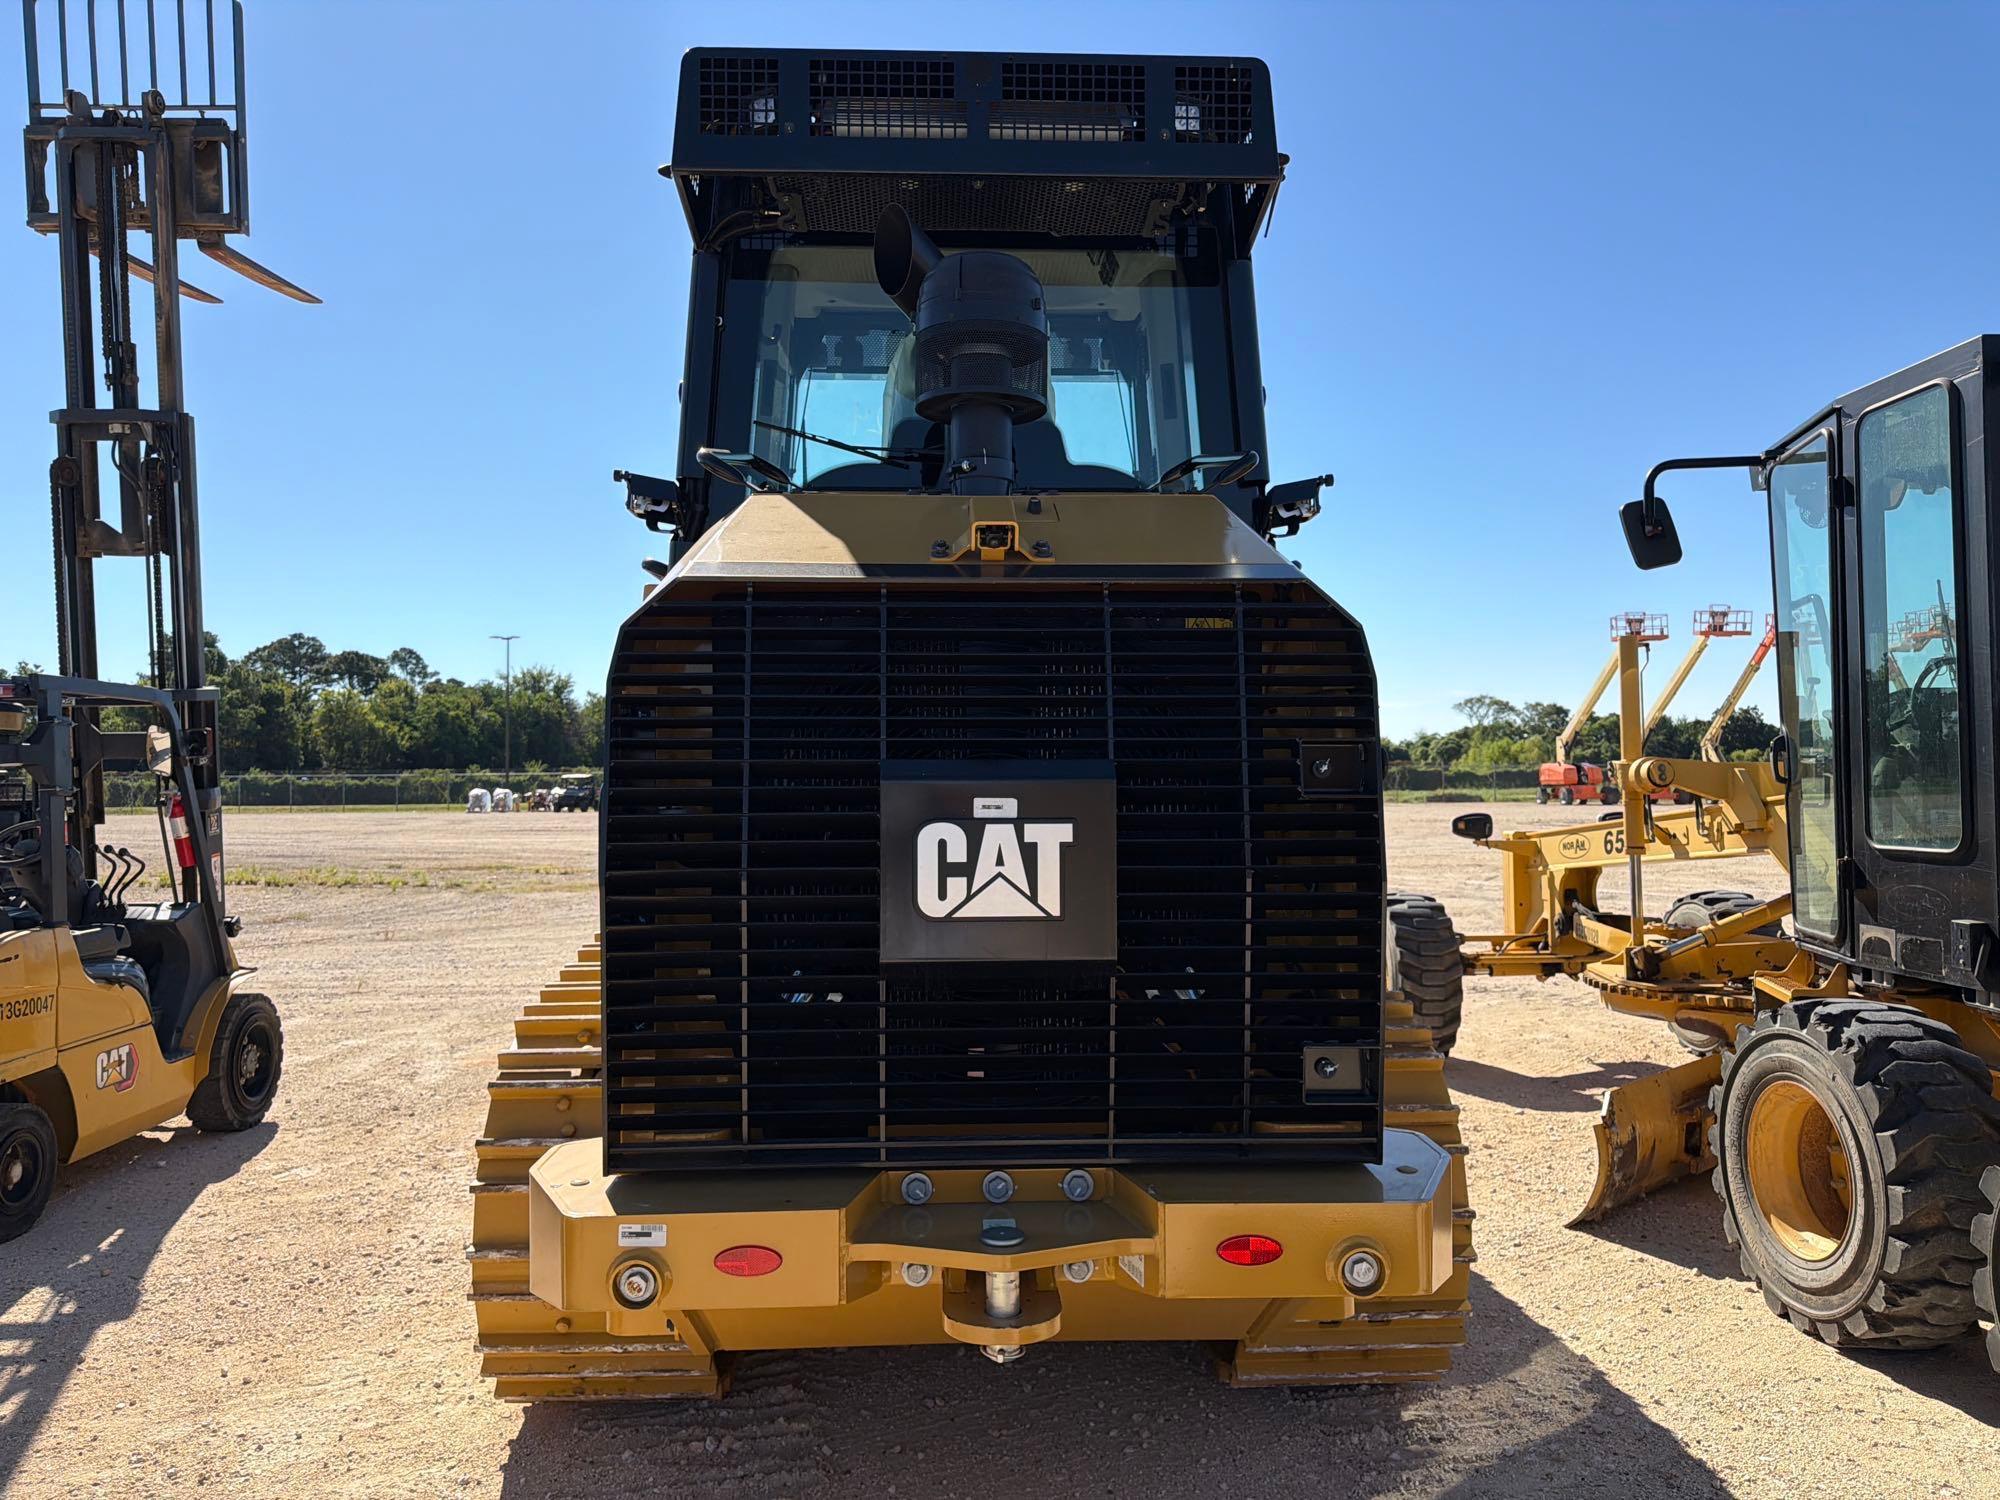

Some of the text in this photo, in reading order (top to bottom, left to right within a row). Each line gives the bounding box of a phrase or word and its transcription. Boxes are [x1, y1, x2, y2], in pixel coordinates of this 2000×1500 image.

[1604, 829, 1625, 855] 65
[917, 822, 1073, 918] CAT
[97, 1044, 130, 1089] CAT
